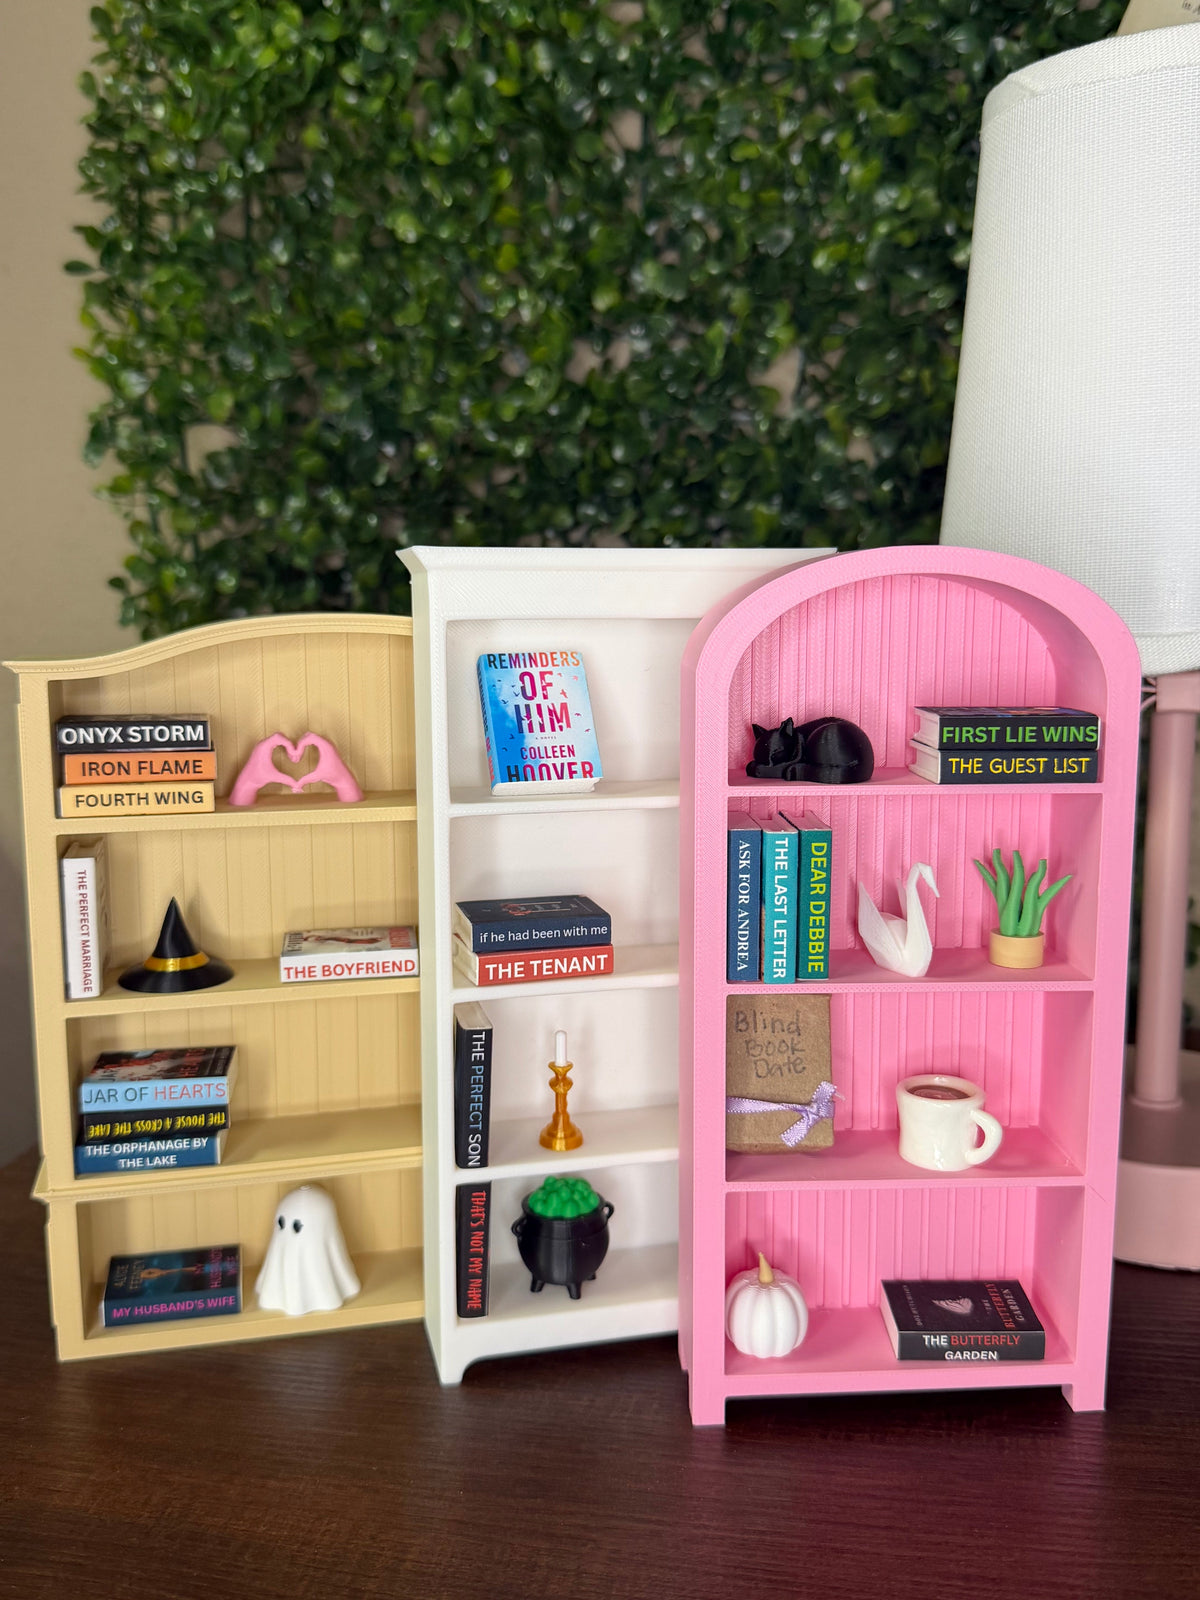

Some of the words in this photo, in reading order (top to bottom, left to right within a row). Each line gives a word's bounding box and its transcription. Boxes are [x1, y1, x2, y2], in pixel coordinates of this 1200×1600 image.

[486, 652, 580, 669] REMINDERS
[519, 670, 554, 700] OF
[514, 702, 572, 734] HIM
[60, 727, 124, 744] ONYX
[127, 724, 204, 742] STORM
[942, 726, 1000, 743] FIRST
[1006, 726, 1037, 742] LIE
[1042, 726, 1098, 742] WINS
[520, 744, 576, 760] COLLEEN
[81, 761, 130, 776] IRON
[138, 760, 203, 775] FLAME
[948, 758, 983, 774] THE
[989, 758, 1048, 774] GUEST
[1054, 758, 1090, 774] LIST
[75, 792, 149, 808] FOURTH
[154, 790, 204, 806] WING
[738, 840, 750, 869] ASK
[774, 837, 788, 870] THE
[810, 842, 828, 895] DEAR
[77, 870, 88, 890] THE
[738, 874, 750, 904] FOR
[774, 875, 788, 915] LAST
[79, 892, 90, 937] PERFECT
[480, 932, 488, 944] if
[491, 932, 505, 942] he
[508, 930, 530, 941] had
[532, 928, 560, 940] been
[563, 926, 588, 937] with
[590, 925, 608, 934] me
[736, 908, 750, 971] ANDREA
[808, 901, 826, 973] DEBBIE
[772, 920, 788, 978] LETTER
[81, 940, 92, 993] MARRIAGE
[284, 966, 317, 979] THE
[322, 960, 416, 977] BOYFRIEND
[485, 961, 525, 980] THE
[530, 954, 608, 976] TENANT
[735, 1008, 801, 1036] Blind
[472, 1031, 486, 1062] THE
[84, 1088, 118, 1104] JAR
[124, 1086, 149, 1102] OF
[154, 1082, 226, 1100] HEARTS
[470, 1066, 484, 1130] PERFECT
[112, 1122, 132, 1134] THE
[176, 1113, 205, 1127] HOUSE
[207, 1112, 226, 1124] THE
[88, 1124, 110, 1138] LAKE
[86, 1144, 110, 1156] THE
[112, 1138, 190, 1154] ORPHANAGE
[194, 1137, 208, 1148] BY
[468, 1134, 482, 1167] SON
[119, 1157, 144, 1168] THE
[146, 1154, 178, 1166] LAKE
[470, 1190, 486, 1228] THAT'S
[470, 1231, 484, 1254] NOT
[468, 1257, 482, 1274] MY
[466, 1278, 482, 1309] NAME
[112, 1307, 131, 1318] MY
[134, 1299, 204, 1316] HUSBAND'S
[206, 1296, 236, 1308] WIFE
[922, 1334, 948, 1347] THE
[950, 1335, 1020, 1346] BUTTERFLY
[944, 1350, 998, 1360] GARDEN
